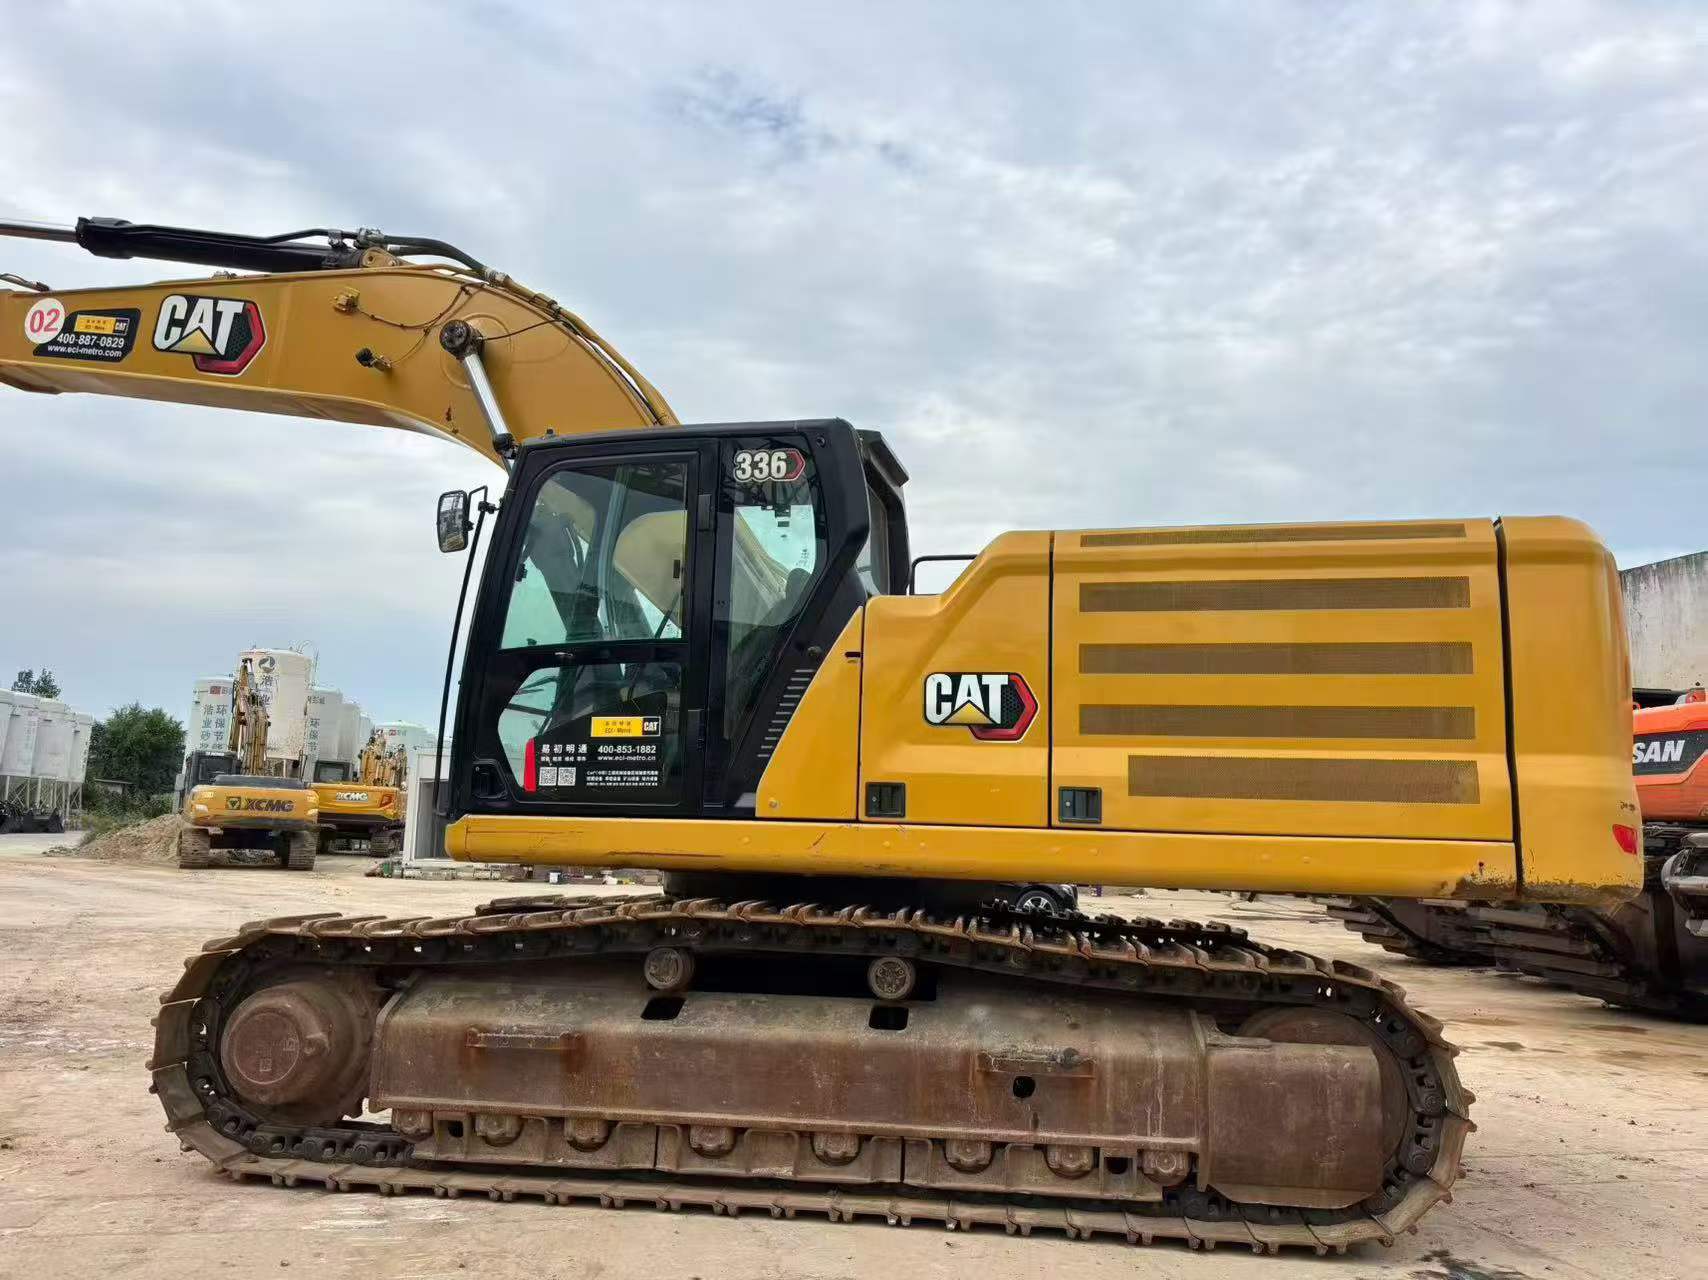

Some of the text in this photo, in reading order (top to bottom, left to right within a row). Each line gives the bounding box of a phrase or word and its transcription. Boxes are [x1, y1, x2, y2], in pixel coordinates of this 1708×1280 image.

[29, 308, 61, 333] 02
[115, 321, 128, 331] CAT
[153, 294, 246, 357] CAT
[57, 333, 125, 349] 400-887-0829
[47, 345, 122, 358] www.eci-metro.com
[735, 451, 788, 480] 336
[925, 673, 1009, 724] CAT
[643, 721, 659, 731] CAT
[597, 745, 657, 754] 400-853-1882
[242, 797, 294, 813] XCMG
